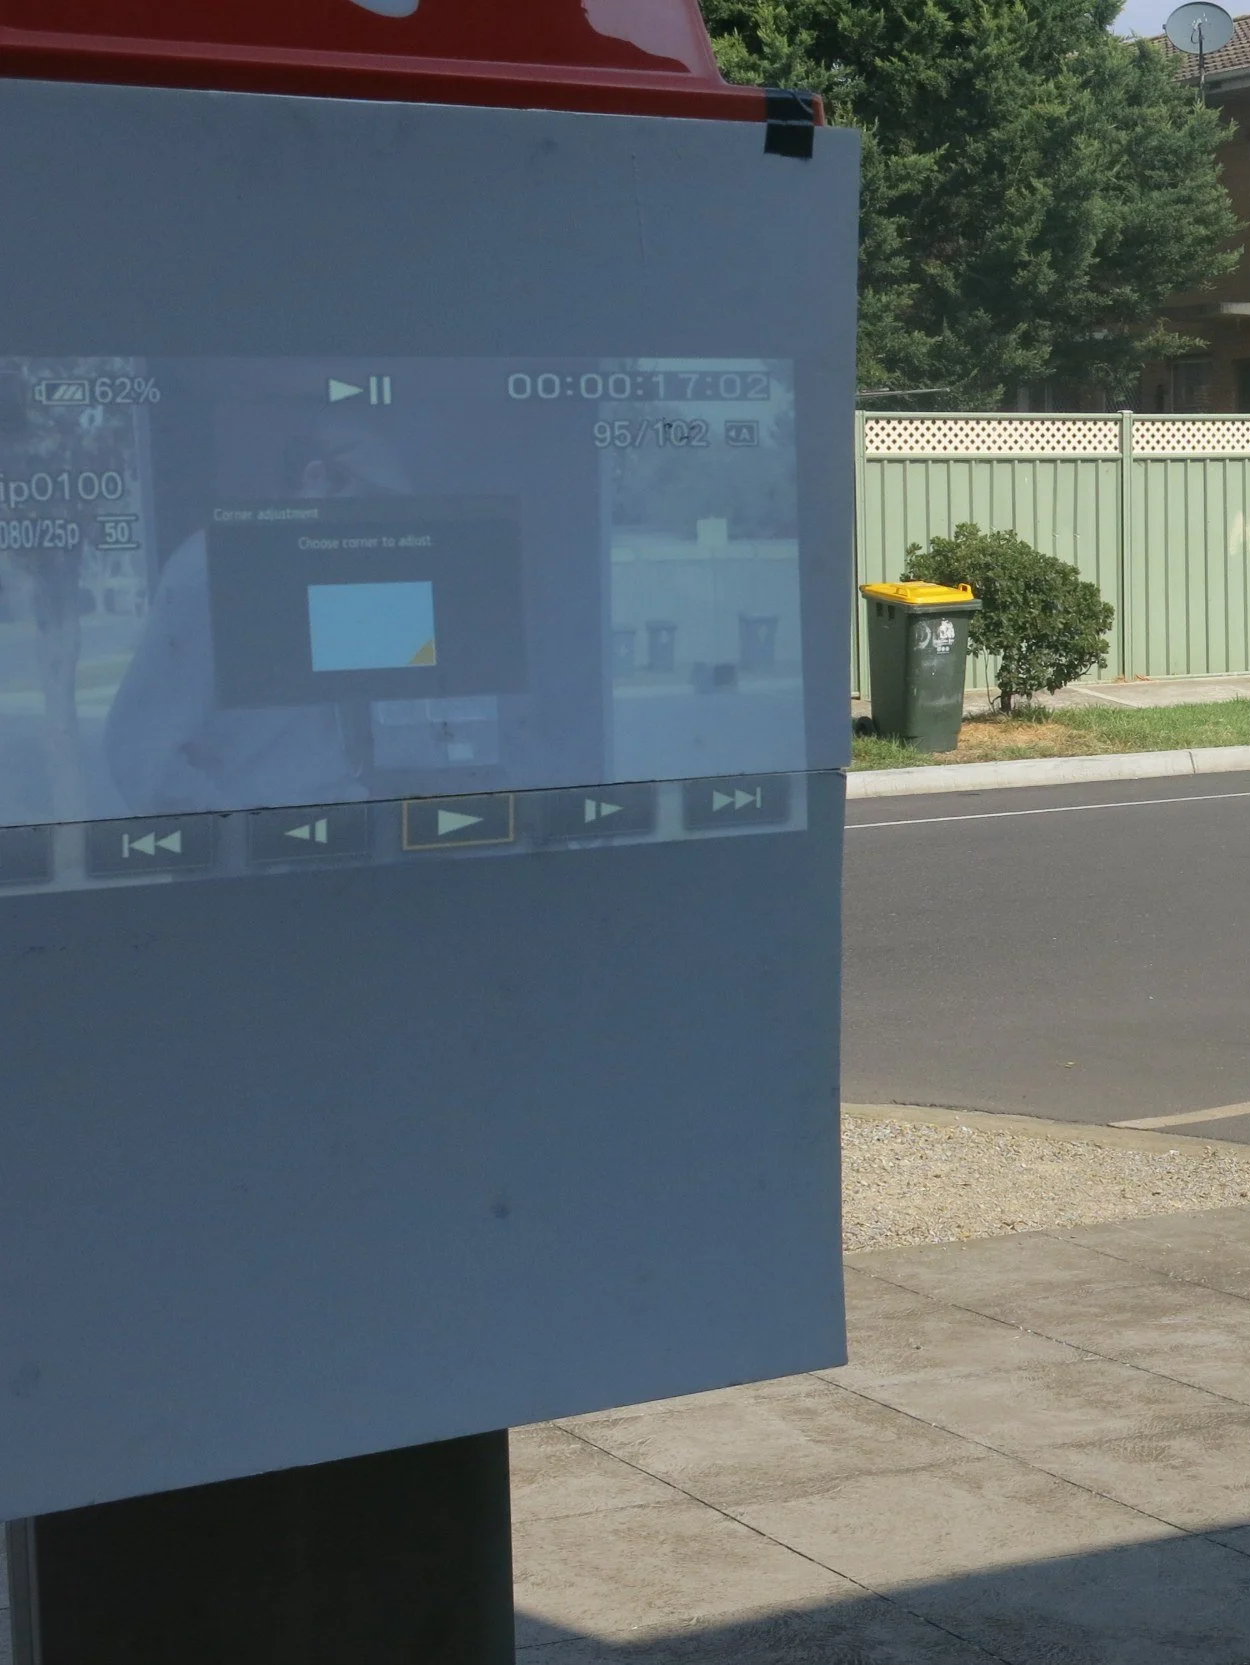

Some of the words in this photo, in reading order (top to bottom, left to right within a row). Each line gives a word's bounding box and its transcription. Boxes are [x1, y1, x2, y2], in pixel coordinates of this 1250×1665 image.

[95, 377, 161, 403] 62%
[508, 373, 769, 400] 00:00:17:02
[593, 420, 709, 449] 95/102
[213, 508, 253, 522] Corner
[257, 507, 320, 522] adjustment
[105, 522, 130, 543] 50
[298, 537, 339, 551] Choose
[342, 537, 379, 549] corner
[382, 536, 395, 548] to
[398, 534, 432, 550] adjust
